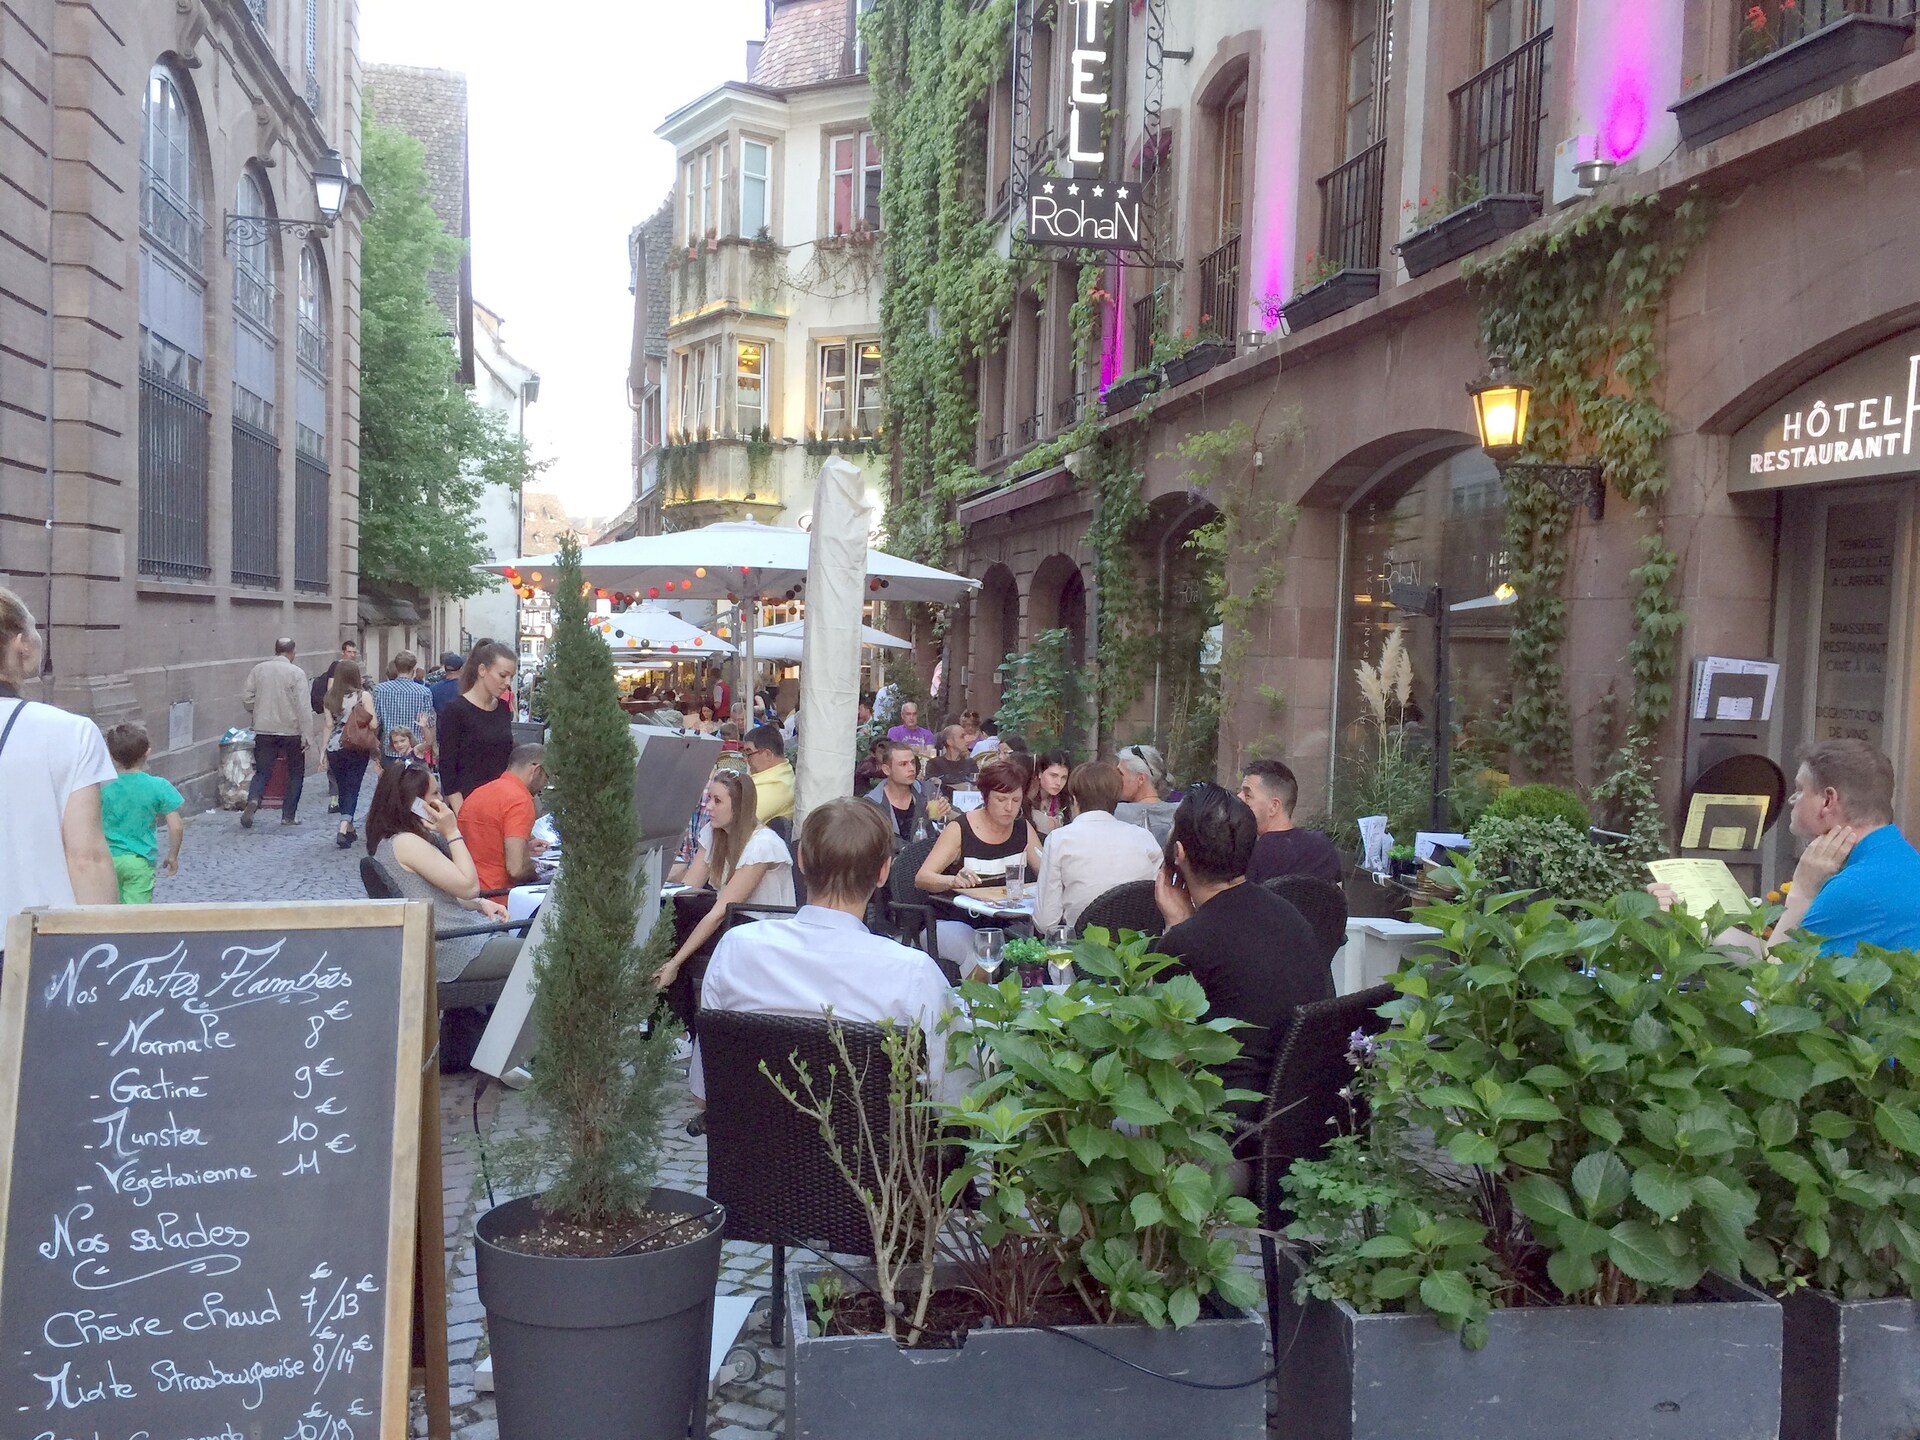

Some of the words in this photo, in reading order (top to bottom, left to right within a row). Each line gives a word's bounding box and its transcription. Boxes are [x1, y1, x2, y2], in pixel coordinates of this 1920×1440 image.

[1031, 195, 1139, 242] RohaN
[1782, 395, 1902, 442] HÔTEL
[1750, 432, 1901, 474] RESTAURANT
[1823, 641, 1888, 655] RESTAURANT
[1829, 622, 1884, 635] BRASSERIE
[1829, 726, 1843, 739] DE
[45, 943, 118, 1006] Nos
[107, 940, 200, 1000] Tartes
[110, 1008, 236, 1057] Normale
[93, 1107, 208, 1156] Munster
[39, 1203, 110, 1259] Nos
[130, 1212, 250, 1251] salades
[183, 1288, 281, 1329] chaud
